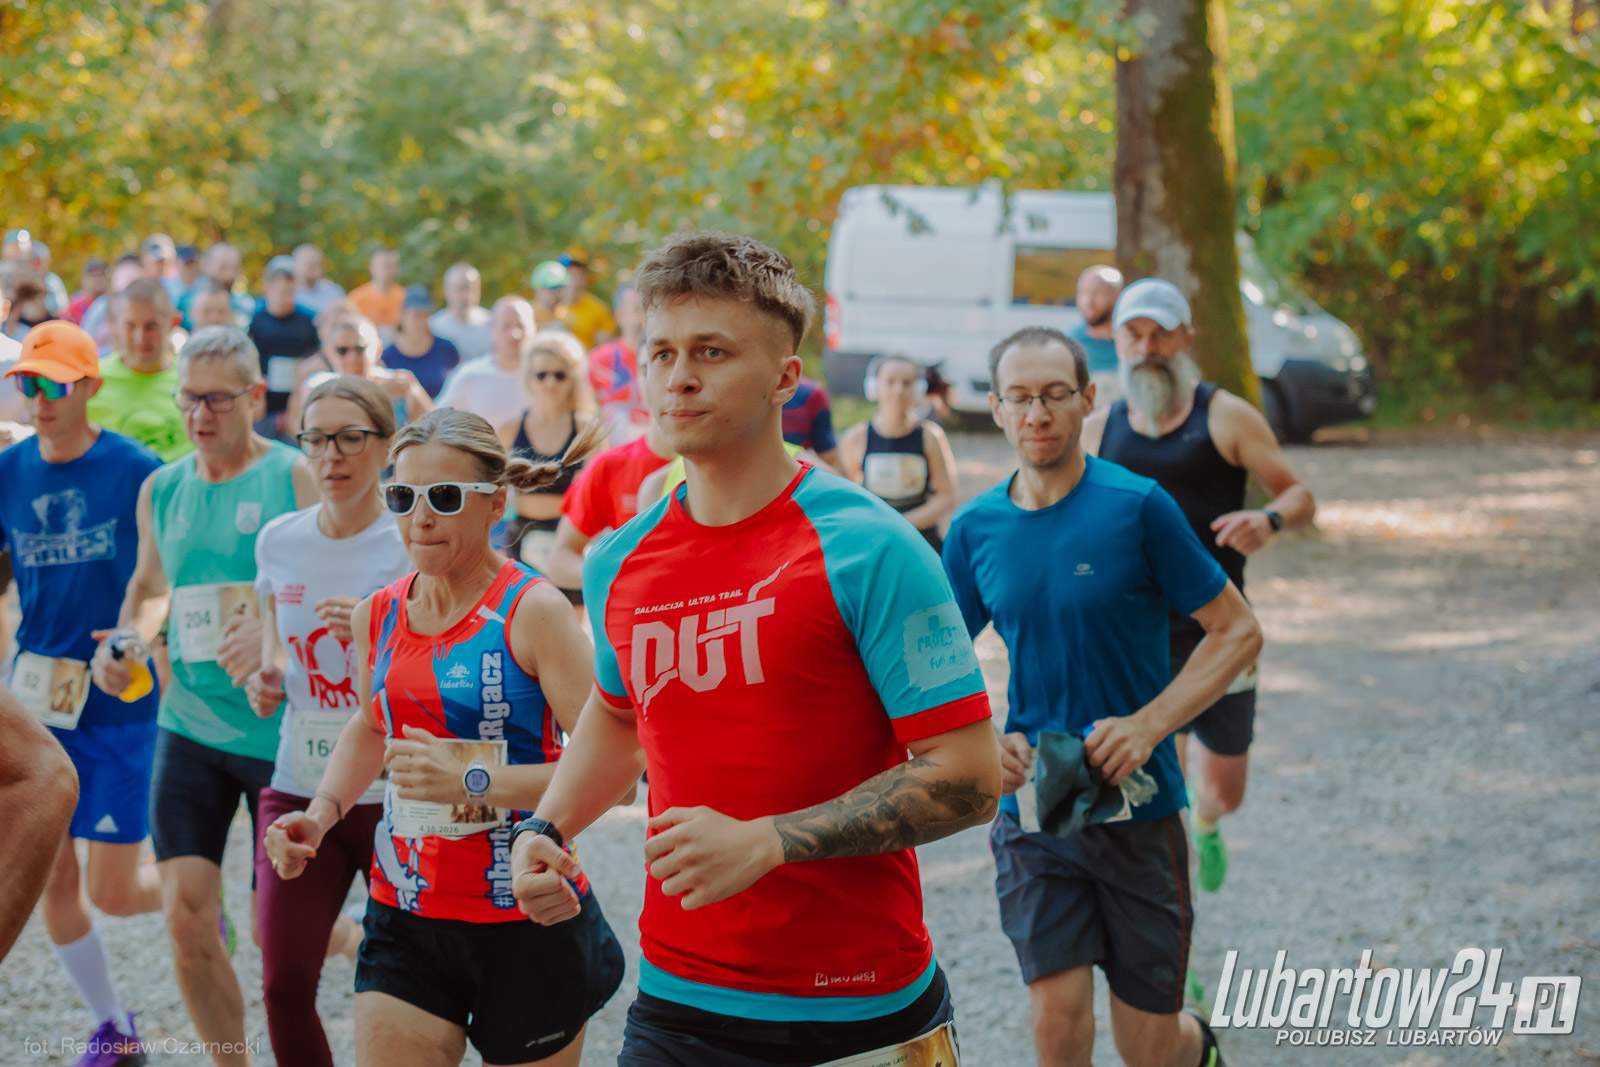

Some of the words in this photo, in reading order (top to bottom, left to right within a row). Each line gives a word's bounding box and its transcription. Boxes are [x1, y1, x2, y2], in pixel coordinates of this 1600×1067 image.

[634, 600, 684, 615] DALMACIJA
[688, 594, 715, 607] ULTRA
[719, 588, 744, 600] TRAIL
[184, 610, 211, 629] 204
[305, 738, 338, 758] 16
